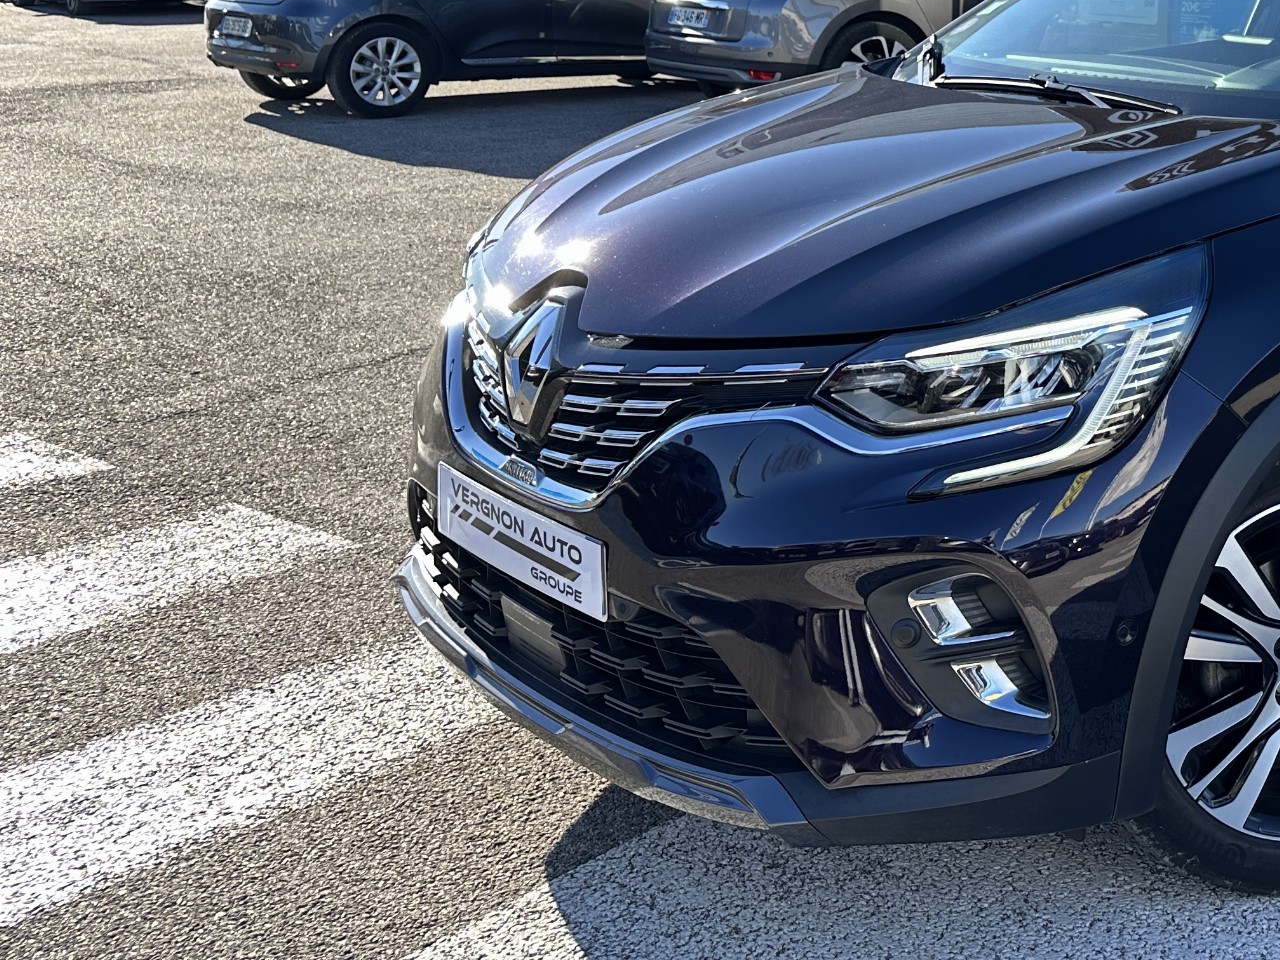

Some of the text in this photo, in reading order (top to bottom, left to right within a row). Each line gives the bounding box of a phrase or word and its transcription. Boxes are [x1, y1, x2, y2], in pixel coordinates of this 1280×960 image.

[451, 478, 583, 566] VERGNON AUTO
[531, 566, 583, 604] GROUPE
